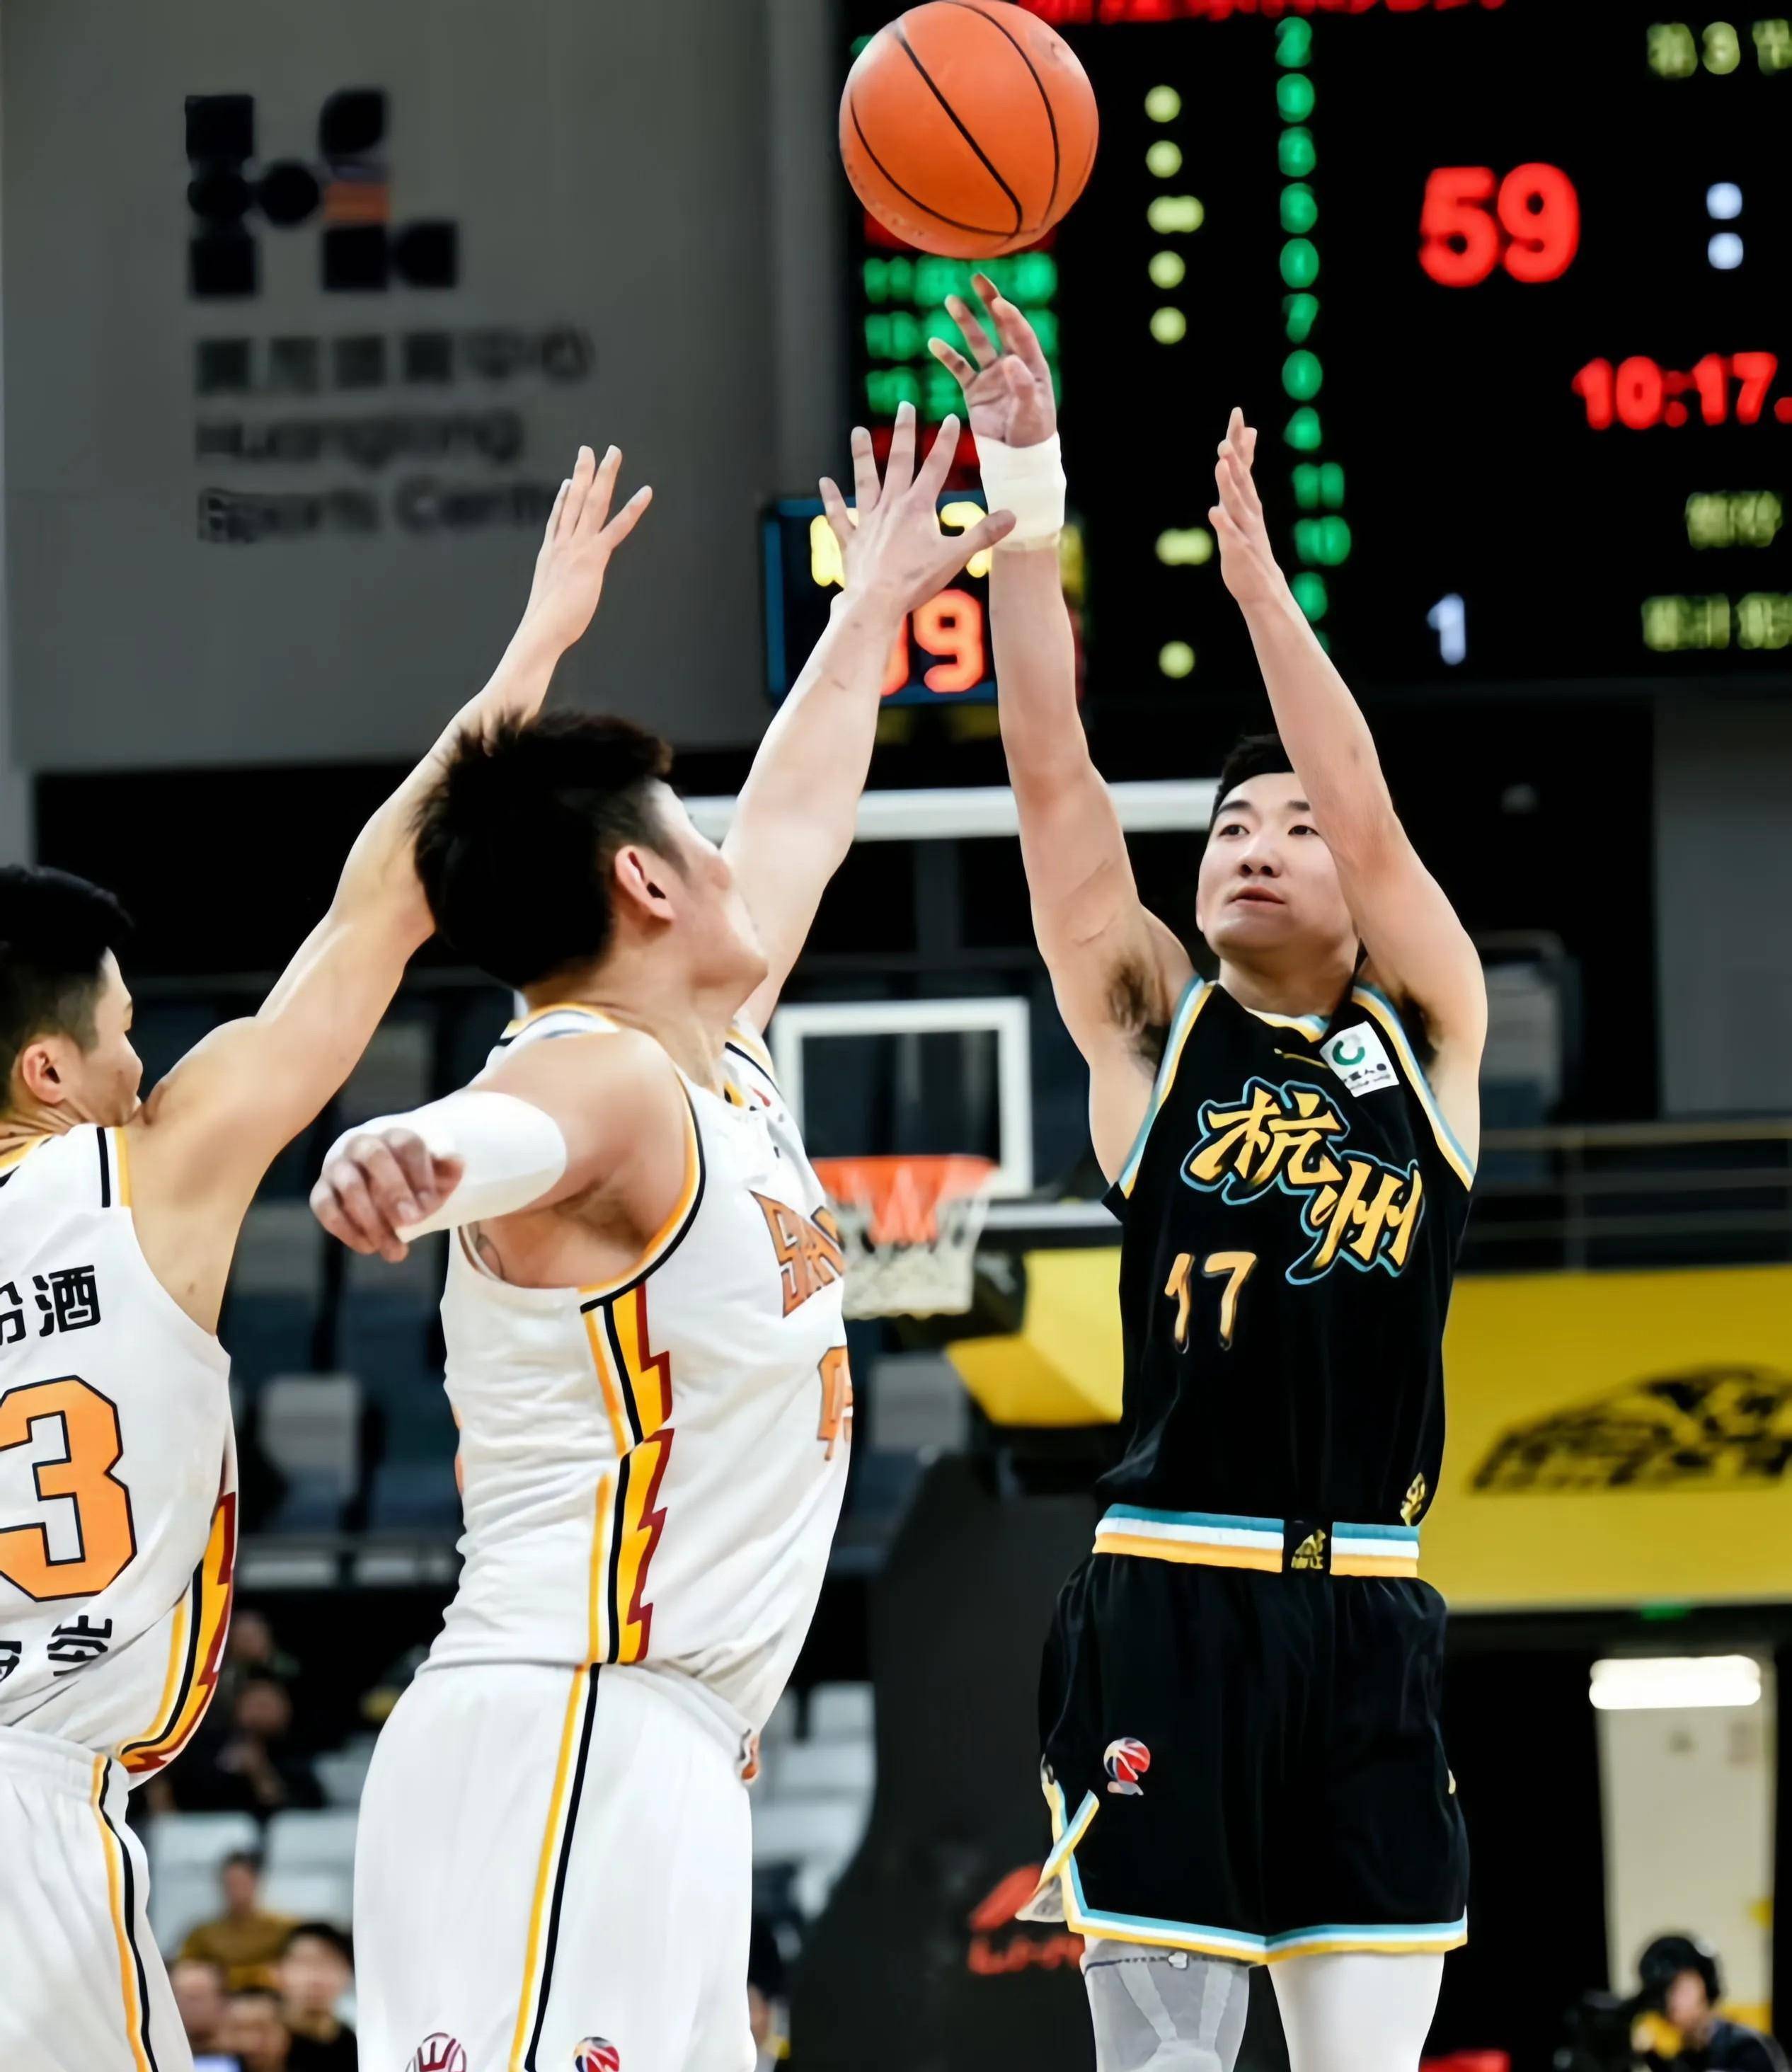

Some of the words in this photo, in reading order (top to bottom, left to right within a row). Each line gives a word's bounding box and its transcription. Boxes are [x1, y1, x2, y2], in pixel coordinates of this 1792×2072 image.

[1418, 162, 1580, 288] 59
[1427, 592, 1467, 666] 1
[1181, 1077, 1425, 1284] 杭州
[1164, 1252, 1257, 1352] 17
